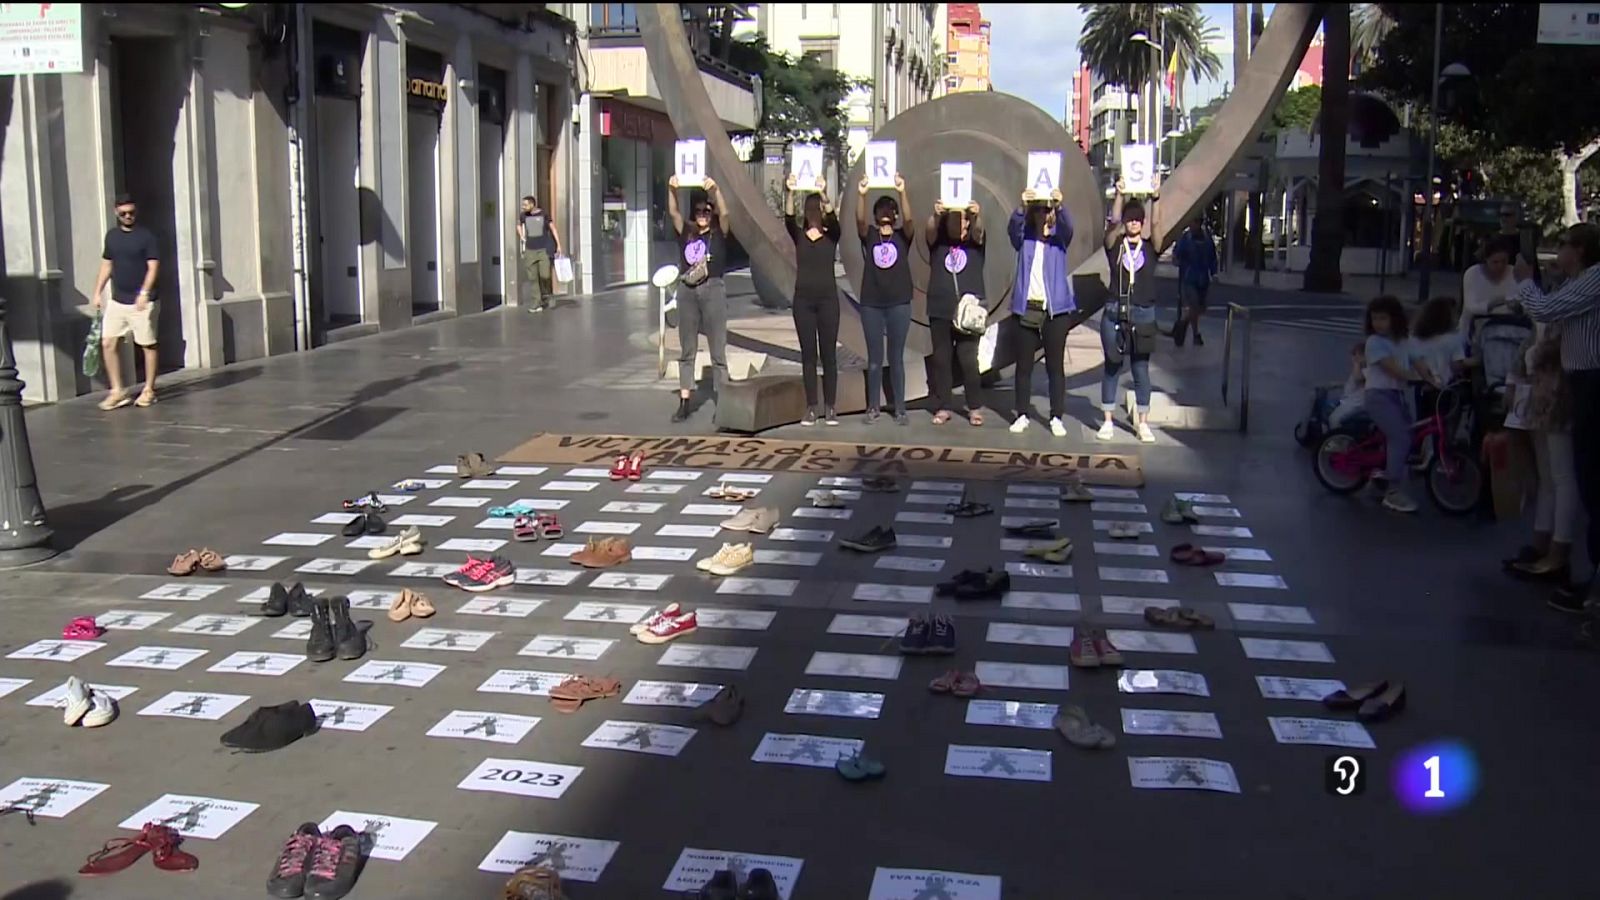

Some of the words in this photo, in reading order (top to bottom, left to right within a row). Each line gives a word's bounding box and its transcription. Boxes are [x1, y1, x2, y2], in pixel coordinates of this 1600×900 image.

[681, 153, 697, 175] H
[798, 159, 814, 180] A
[873, 156, 888, 177] R
[948, 176, 964, 198] T
[1034, 166, 1052, 189] A
[1129, 160, 1144, 182] S
[856, 445, 1128, 470] VIOLENCIA
[480, 768, 564, 787] 2023
